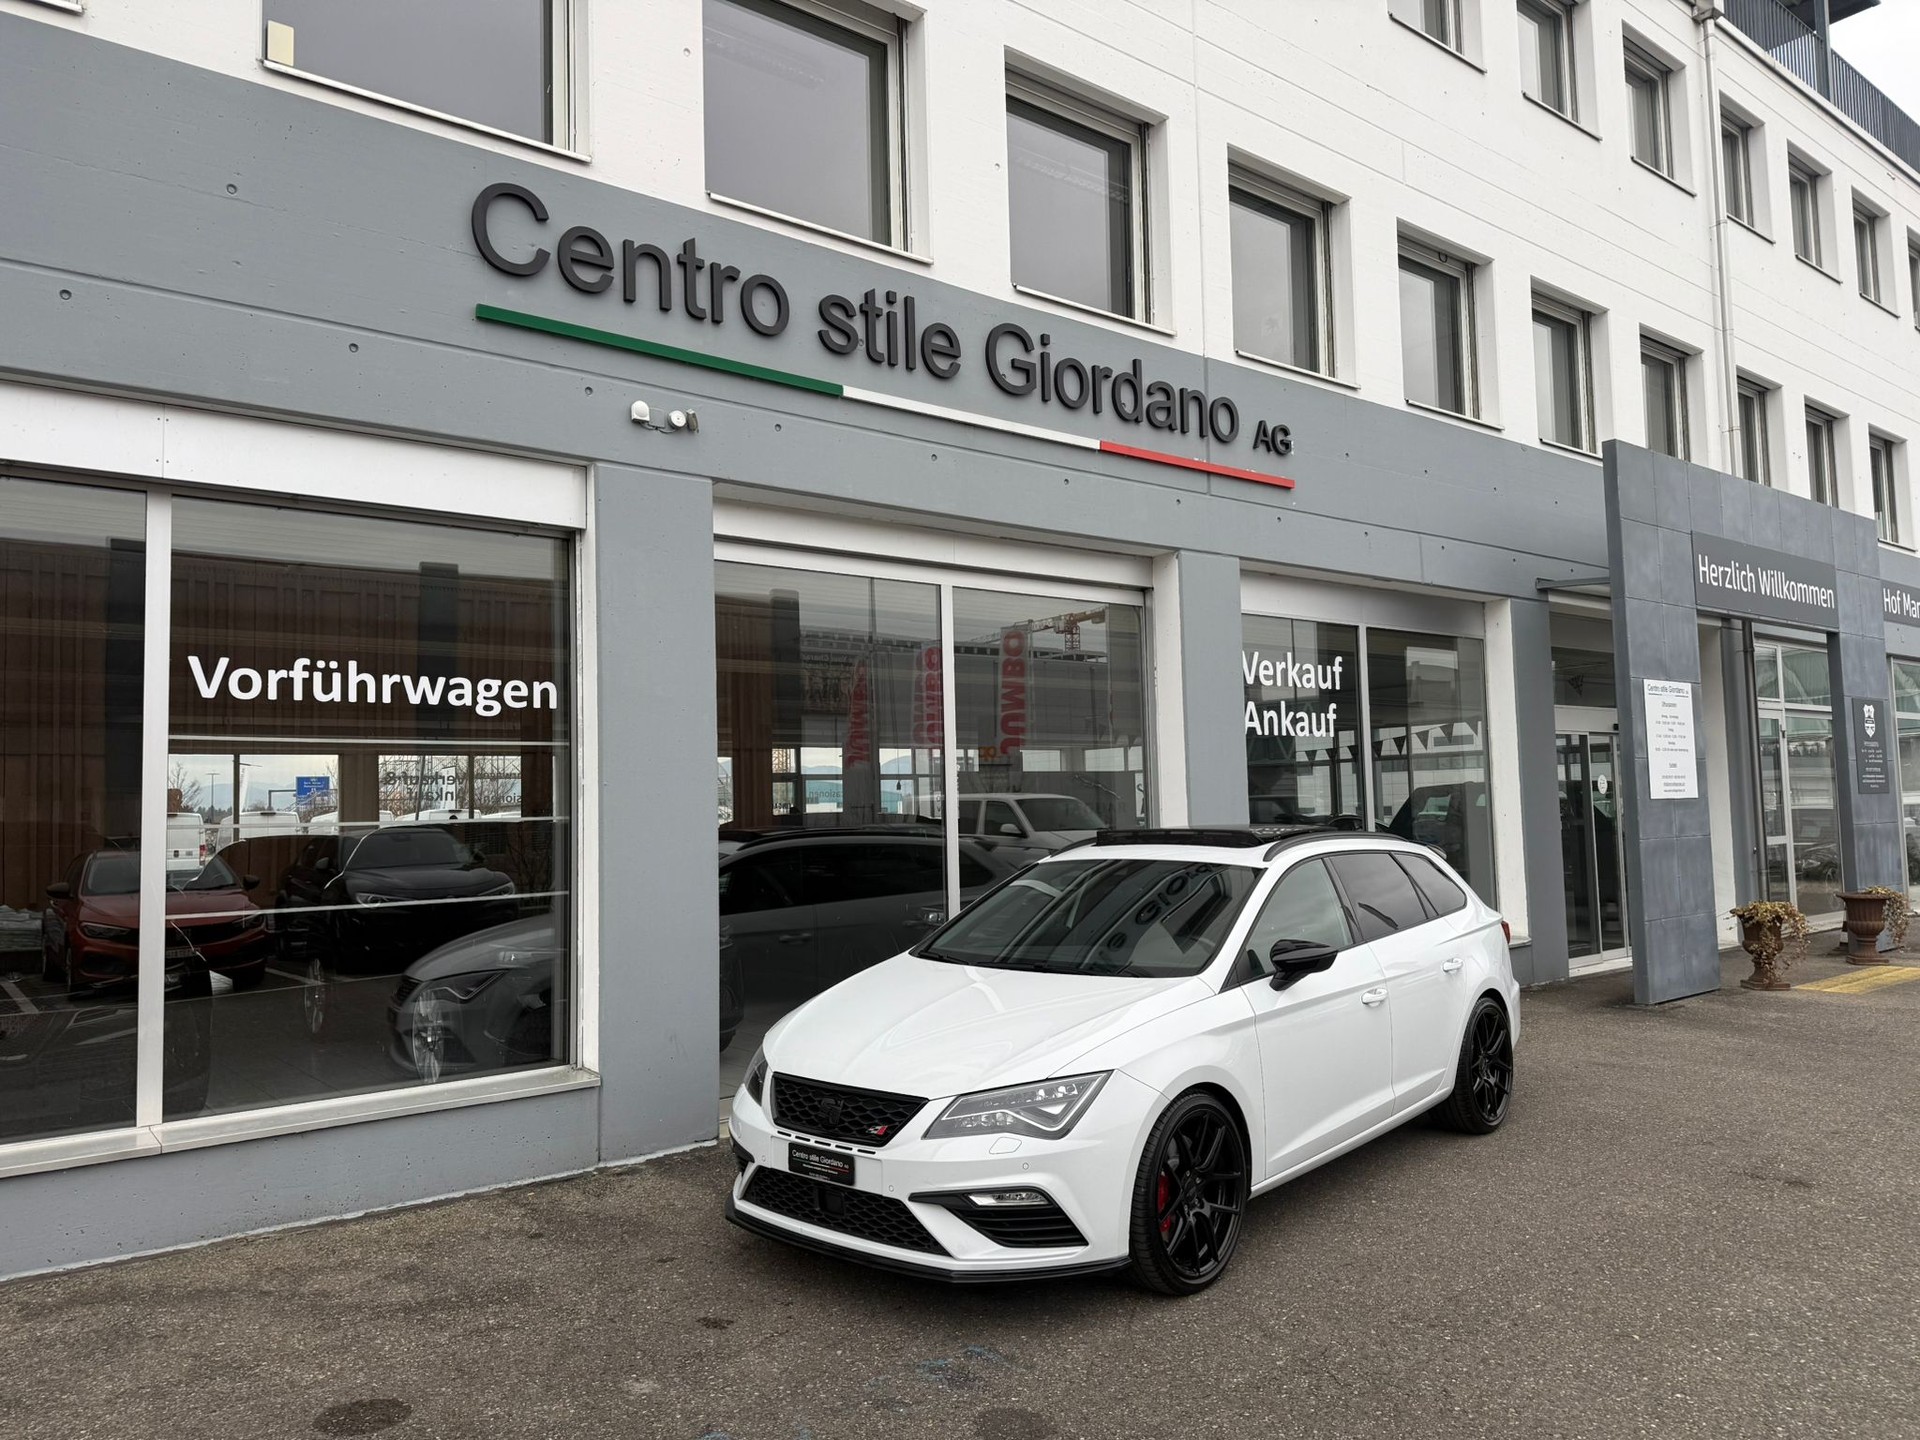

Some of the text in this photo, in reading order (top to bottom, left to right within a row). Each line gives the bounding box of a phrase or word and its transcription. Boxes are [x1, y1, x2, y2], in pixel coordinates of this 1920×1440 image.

[471, 181, 1294, 455] Centro stile Giordano AG
[1698, 554, 1835, 609] Herzlich Willkommen
[1883, 587, 1901, 614] Hof
[187, 655, 558, 716] Vorführwagen
[1242, 650, 1343, 690] Verkauf
[1244, 700, 1337, 738] Ankauf
